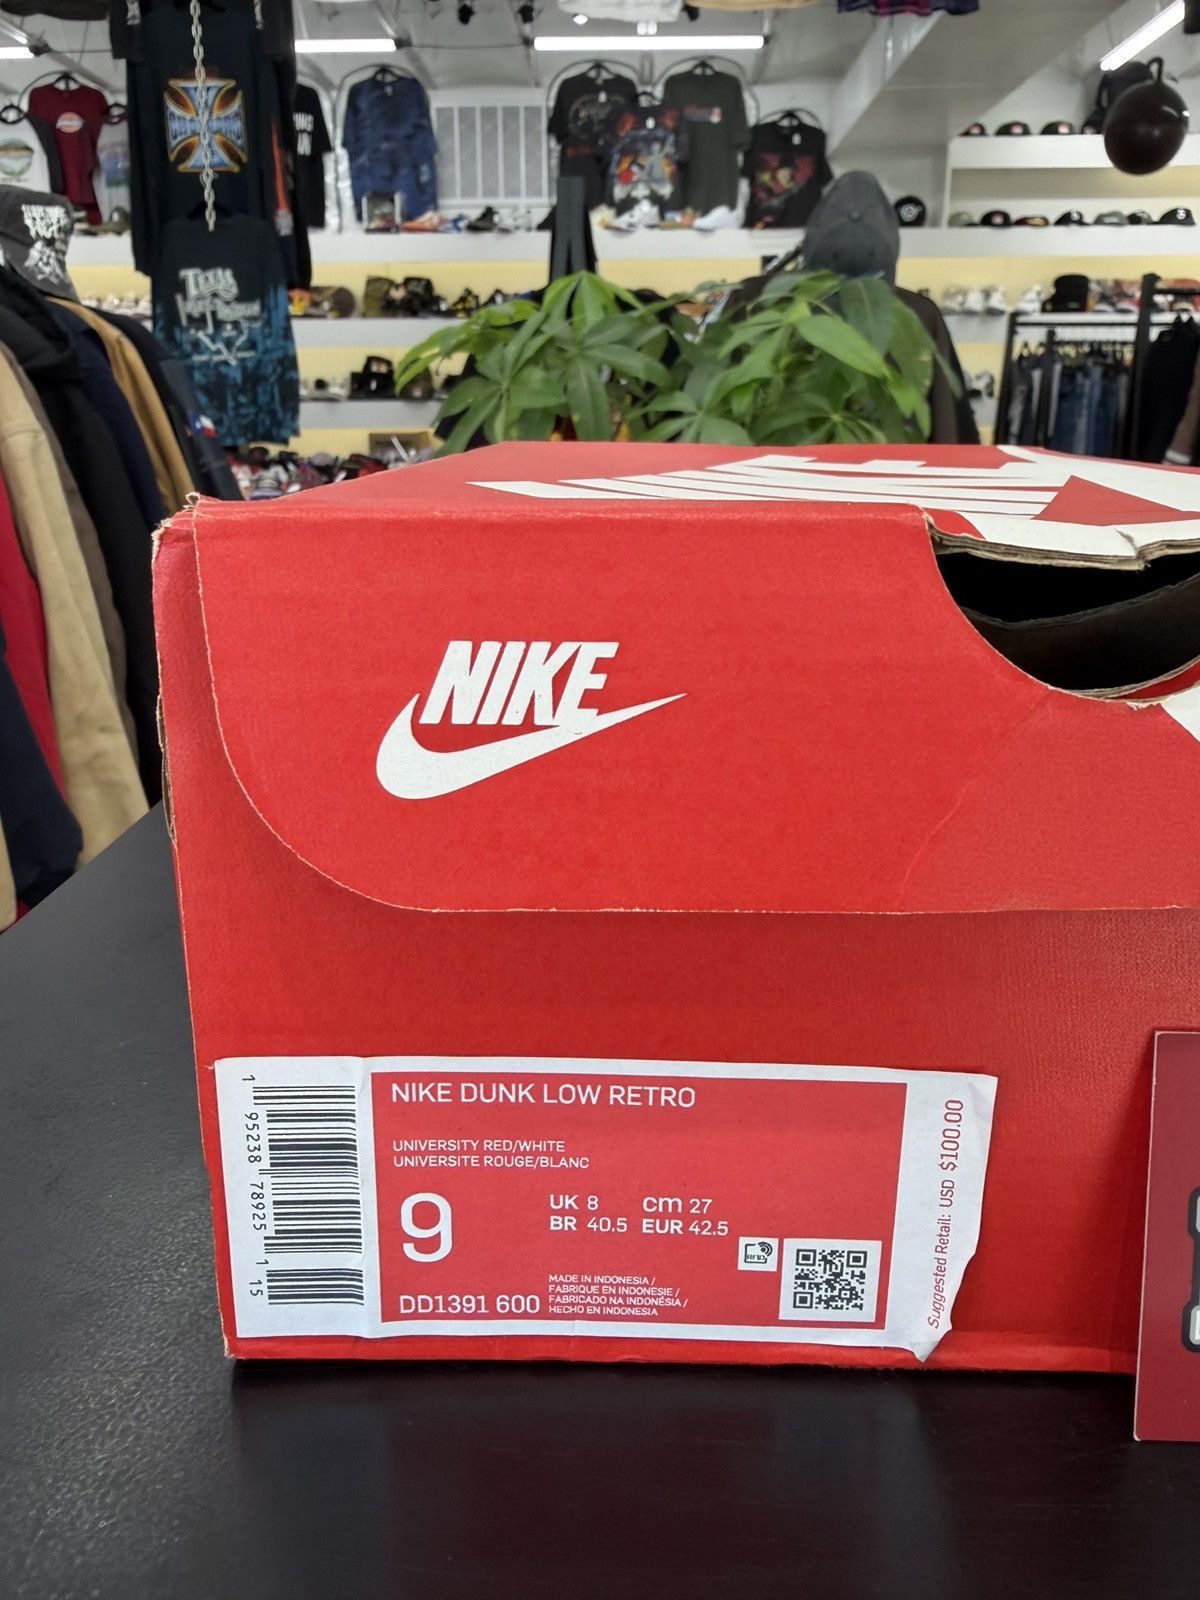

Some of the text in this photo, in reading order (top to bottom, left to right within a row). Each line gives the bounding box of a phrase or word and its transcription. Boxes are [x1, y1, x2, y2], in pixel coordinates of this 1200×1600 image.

[418, 640, 620, 726] NIKE
[242, 1074, 256, 1082] 1
[391, 1082, 696, 1108] NIKE DUNK LOW RETRO
[245, 1112, 262, 1164] 95238
[393, 1139, 566, 1153] UNIVERSITY RED/WHITE
[393, 1155, 590, 1169] UNIVERSITE ROUGE/BLANC
[250, 1182, 267, 1231] 78925
[549, 1194, 599, 1211] UK 8
[642, 1196, 713, 1214] cm 27
[928, 1099, 964, 1330] Suggested Retail: USD $100.00
[401, 1192, 453, 1263] 9
[549, 1215, 628, 1233] BR 40.5
[642, 1218, 729, 1236] EUR 42.5
[249, 1279, 263, 1297] 15
[549, 1274, 579, 1283] MADE
[581, 1275, 592, 1283] IN
[593, 1275, 650, 1285] INDONESIA
[549, 1284, 599, 1294] FABRIQUE
[602, 1285, 616, 1294] EN
[618, 1286, 673, 1296] INDONESIE
[399, 1294, 541, 1314] DD1391 600
[549, 1294, 607, 1304] FABRICADO
[609, 1296, 624, 1305] NA
[626, 1295, 682, 1307] INDONÉSIA
[549, 1305, 659, 1316] HECHO EN INDONESIA
